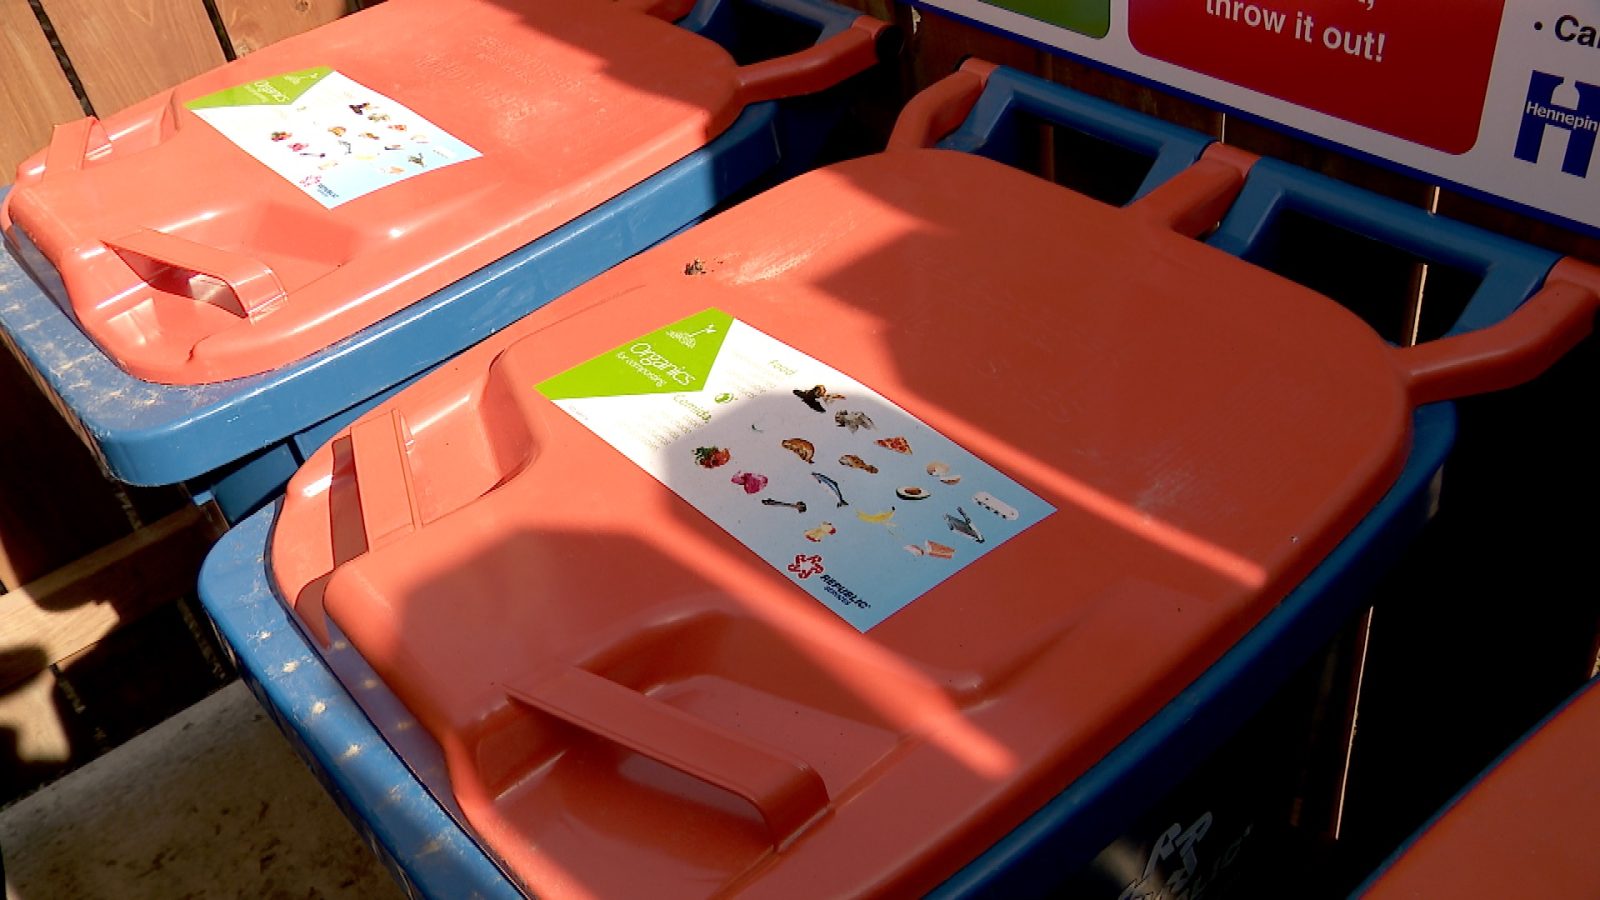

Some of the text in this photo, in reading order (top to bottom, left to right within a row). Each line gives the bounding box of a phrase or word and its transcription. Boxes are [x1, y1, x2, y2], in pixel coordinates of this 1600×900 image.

[1295, 11, 1314, 43] it
[1323, 27, 1386, 62] out!
[1555, 14, 1600, 49] Ca
[1526, 101, 1599, 132] Hennepin
[630, 343, 696, 385] Organics
[820, 574, 869, 609] REPUBLIC
